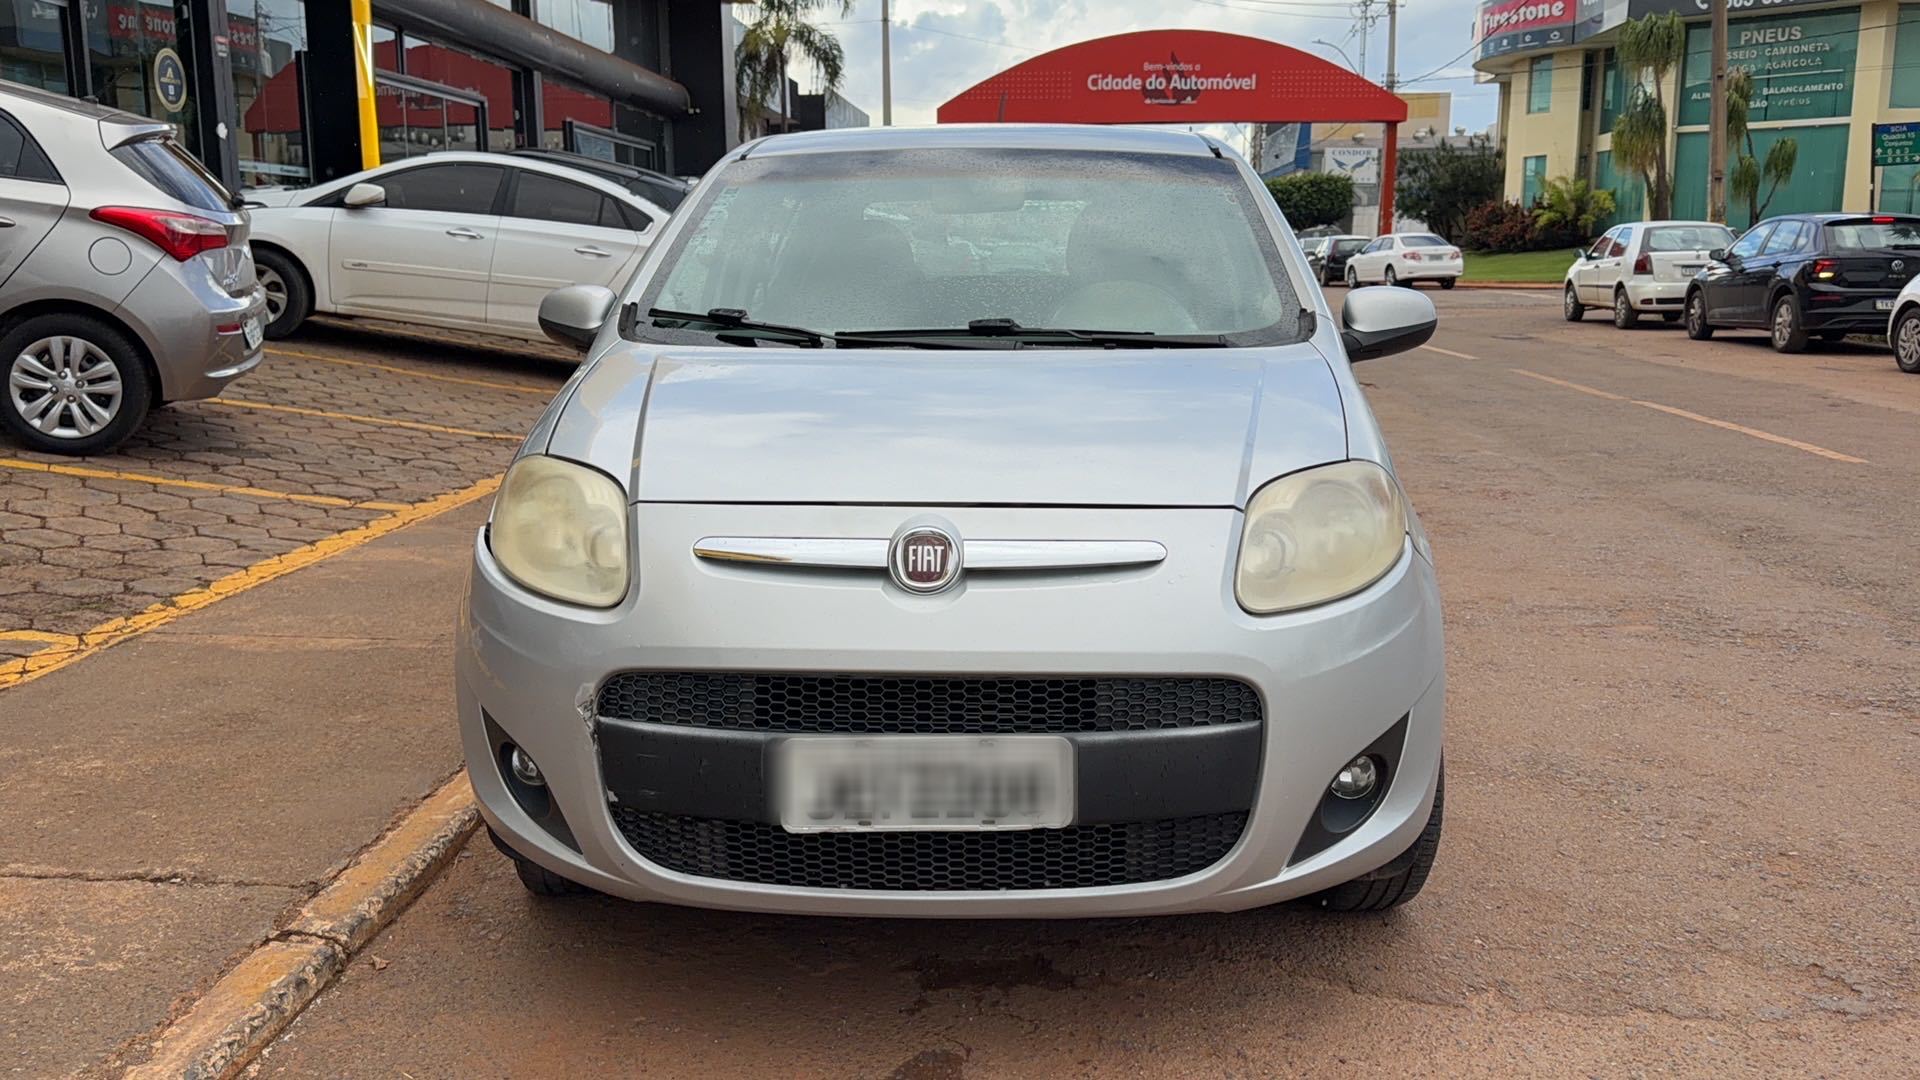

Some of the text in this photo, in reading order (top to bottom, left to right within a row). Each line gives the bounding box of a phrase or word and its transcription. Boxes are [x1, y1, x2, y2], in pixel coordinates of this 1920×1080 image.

[1484, 0, 1565, 35] Firestone
[1740, 26, 1802, 45] PNEUS
[1726, 43, 1830, 60] SSEIO CAMIONETA
[1143, 62, 1193, 71] Bem-vindos
[1087, 72, 1256, 91] Cidade do Automóvel
[1762, 82, 1844, 96] BALANCEAMENTO
[908, 545, 945, 572] FIAT
